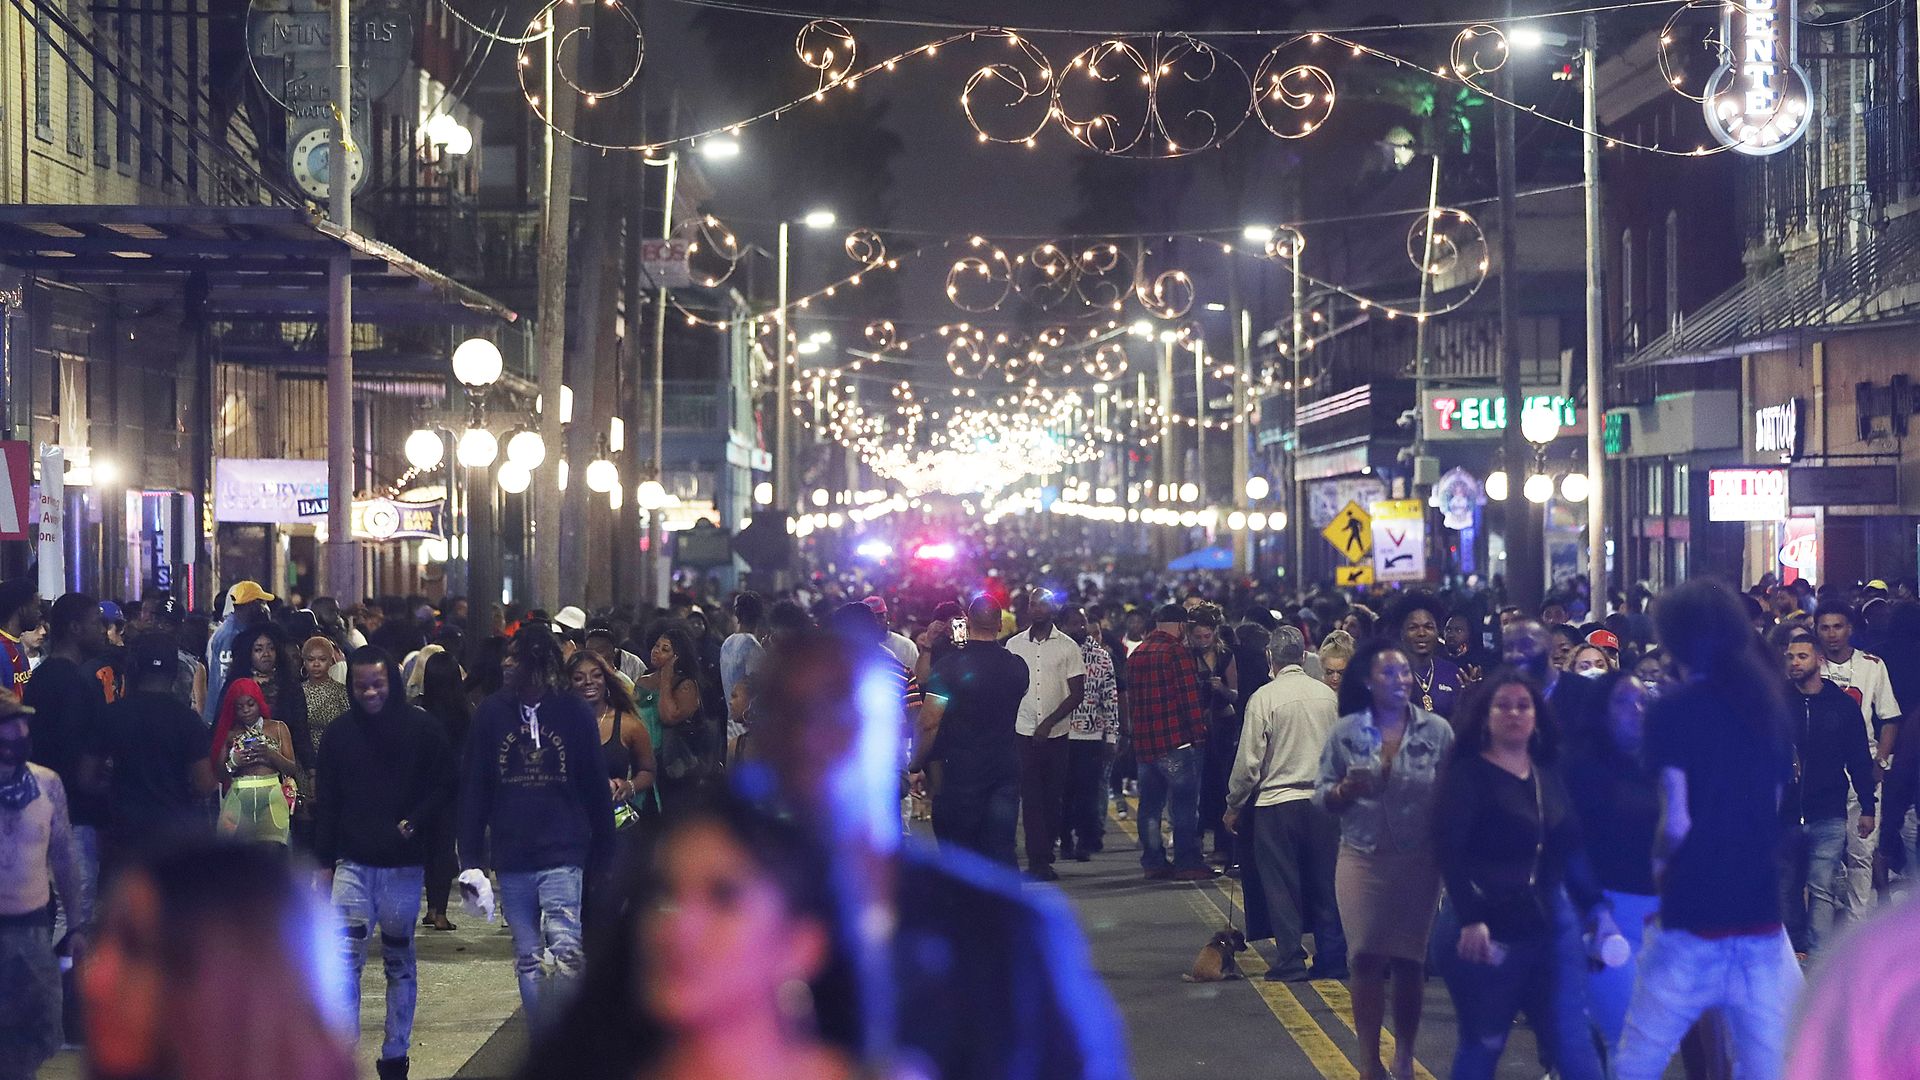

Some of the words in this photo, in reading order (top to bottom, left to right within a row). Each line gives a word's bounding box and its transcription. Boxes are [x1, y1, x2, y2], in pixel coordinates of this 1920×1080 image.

[1717, 99, 1806, 147] CIGARS
[1711, 471, 1784, 495] TATTOO
[499, 732, 517, 775] TRUE
[520, 724, 567, 774] RLIGION
